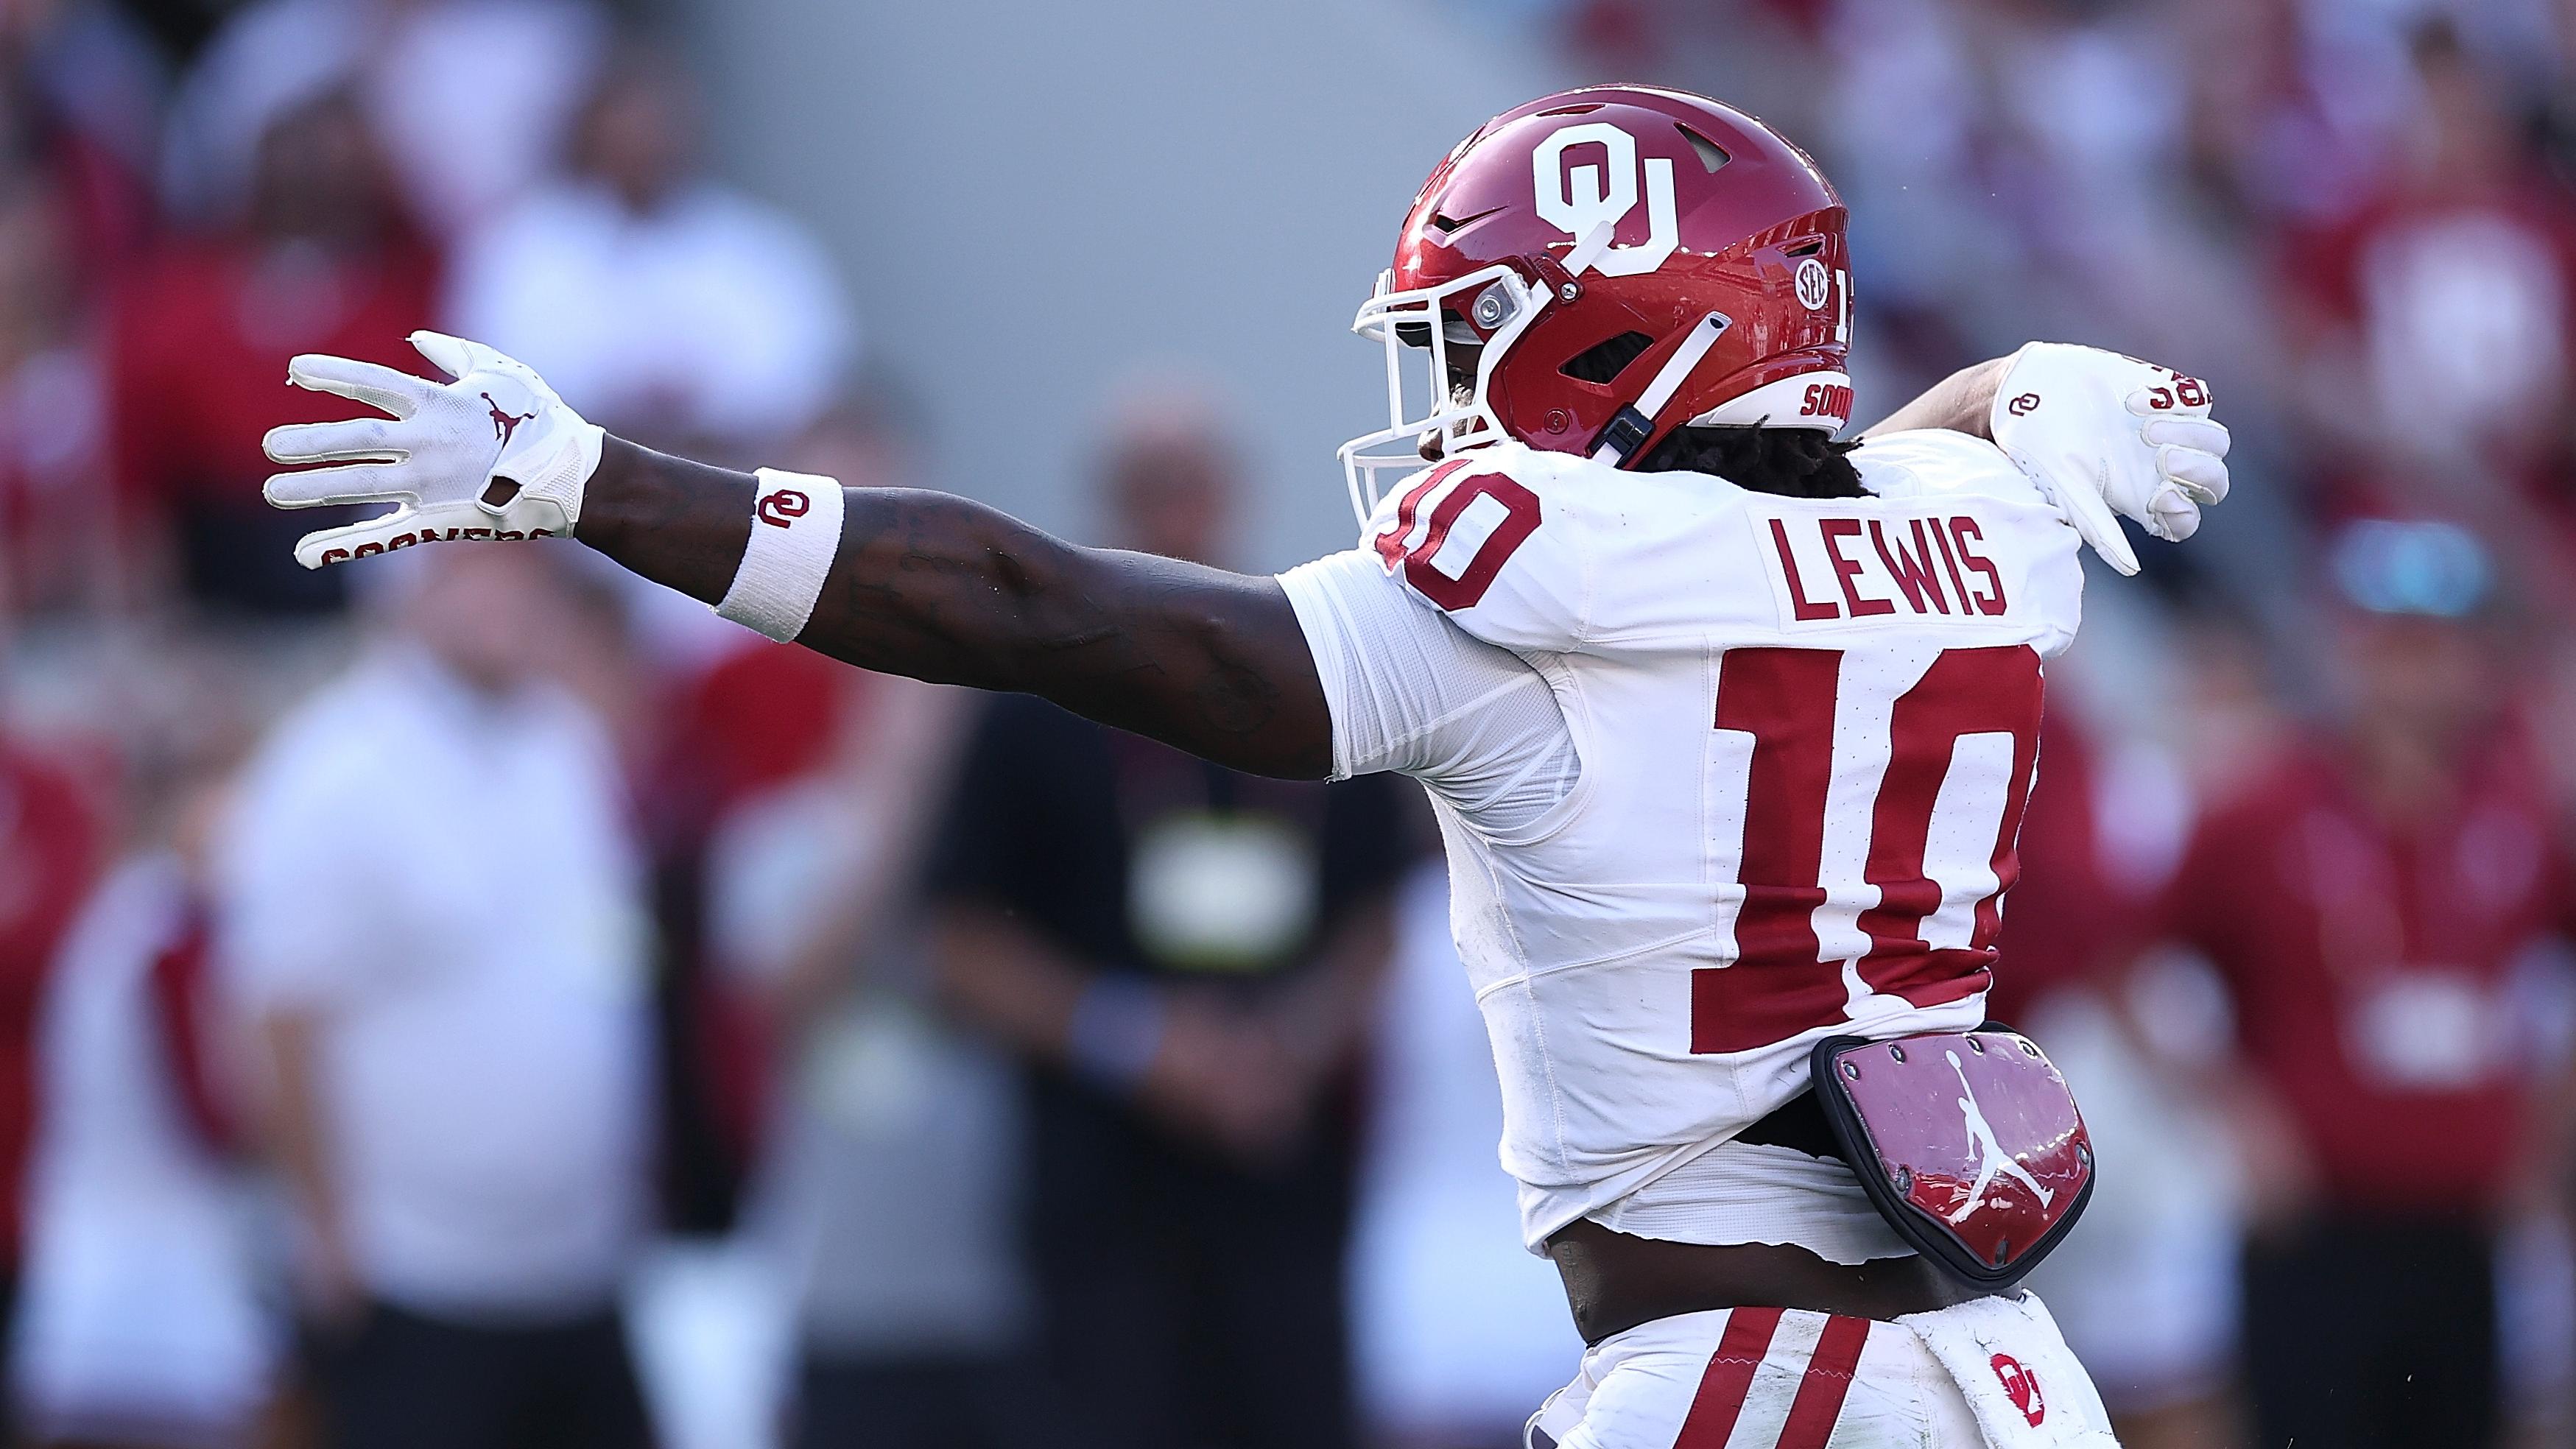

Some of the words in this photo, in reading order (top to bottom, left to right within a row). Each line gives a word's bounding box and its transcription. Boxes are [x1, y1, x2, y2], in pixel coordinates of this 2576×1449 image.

[1532, 122, 1679, 277] OU
[1798, 264, 1826, 305] SEC
[1834, 269, 1854, 349] 1
[758, 489, 810, 529] OU
[1374, 459, 1543, 612] 10
[1768, 516, 2007, 621] LEWIS
[1689, 644, 2044, 1054] 10
